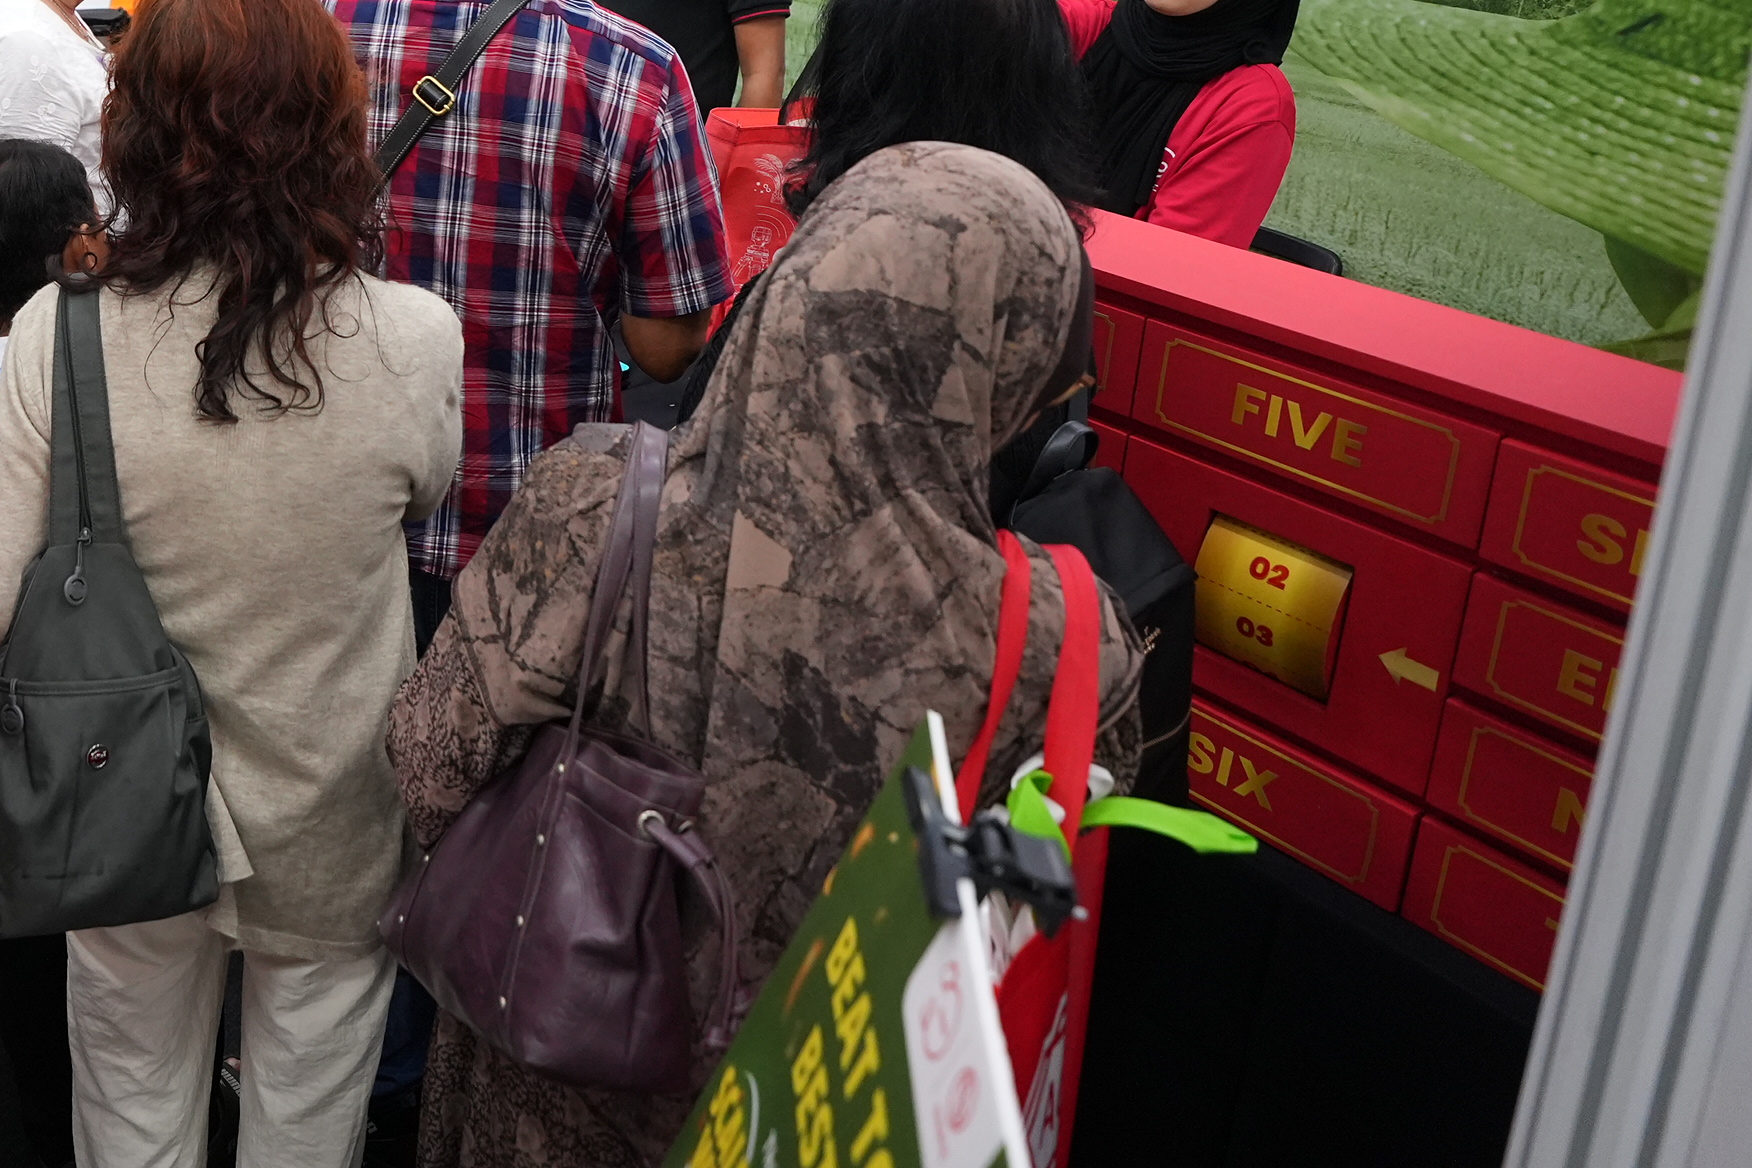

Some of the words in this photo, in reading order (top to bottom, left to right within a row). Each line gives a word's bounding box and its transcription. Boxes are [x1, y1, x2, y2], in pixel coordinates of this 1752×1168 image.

[1231, 382, 1368, 468] FIVE
[1249, 556, 1290, 590] 02
[1236, 616, 1274, 648] 03
[1187, 731, 1280, 811] SIX
[824, 914, 881, 1102] BEAT
